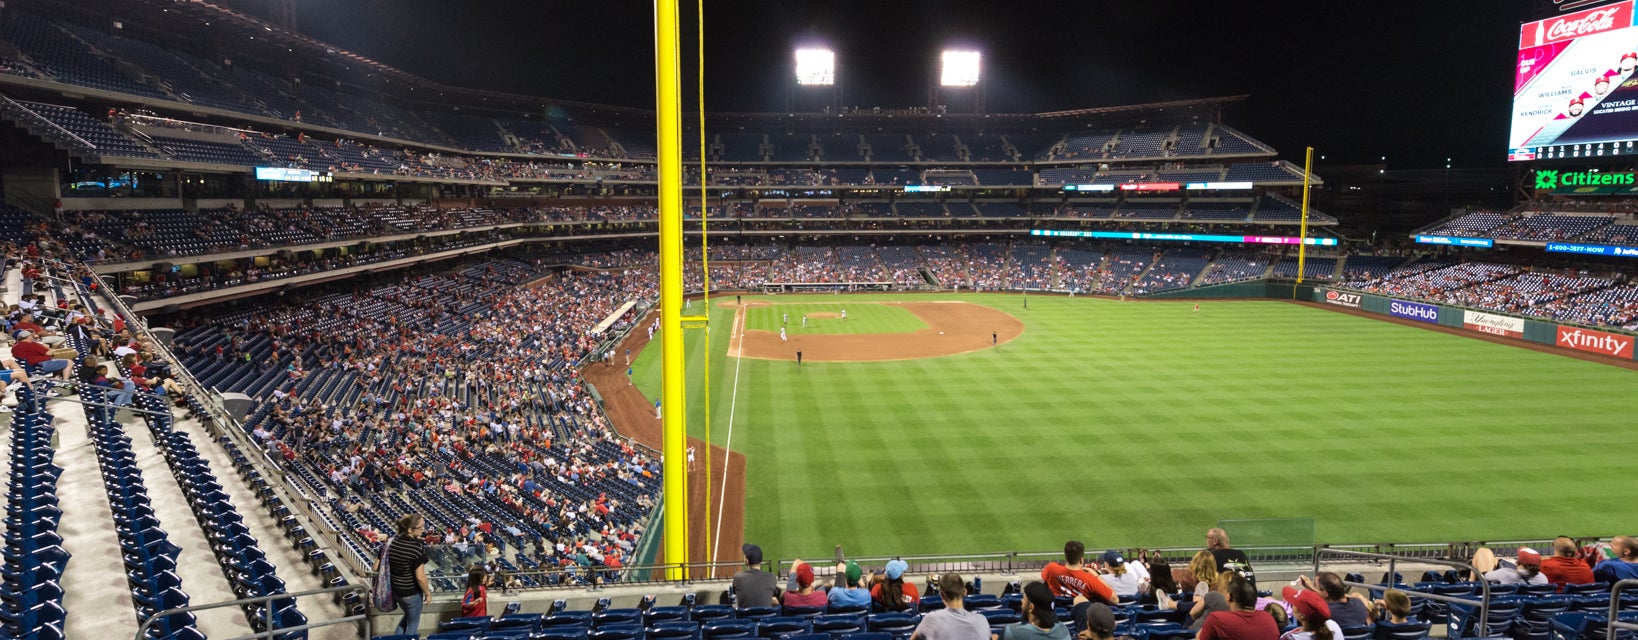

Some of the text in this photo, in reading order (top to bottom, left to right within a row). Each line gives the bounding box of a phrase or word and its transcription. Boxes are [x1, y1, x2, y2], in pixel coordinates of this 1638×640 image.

[1547, 7, 1619, 40] Coca-Cola
[1570, 67, 1597, 77] GALVIS
[1538, 88, 1572, 98] WILLIAMS
[1601, 99, 1636, 109] VINTAGE
[1520, 108, 1553, 117] KENDRICK
[1561, 170, 1635, 186] Citizens
[1337, 293, 1361, 304] ATI
[1391, 302, 1437, 320] StubHub
[1470, 312, 1515, 329] Yuengling
[1478, 325, 1505, 336] LAGER
[1561, 330, 1628, 355] xfinity
